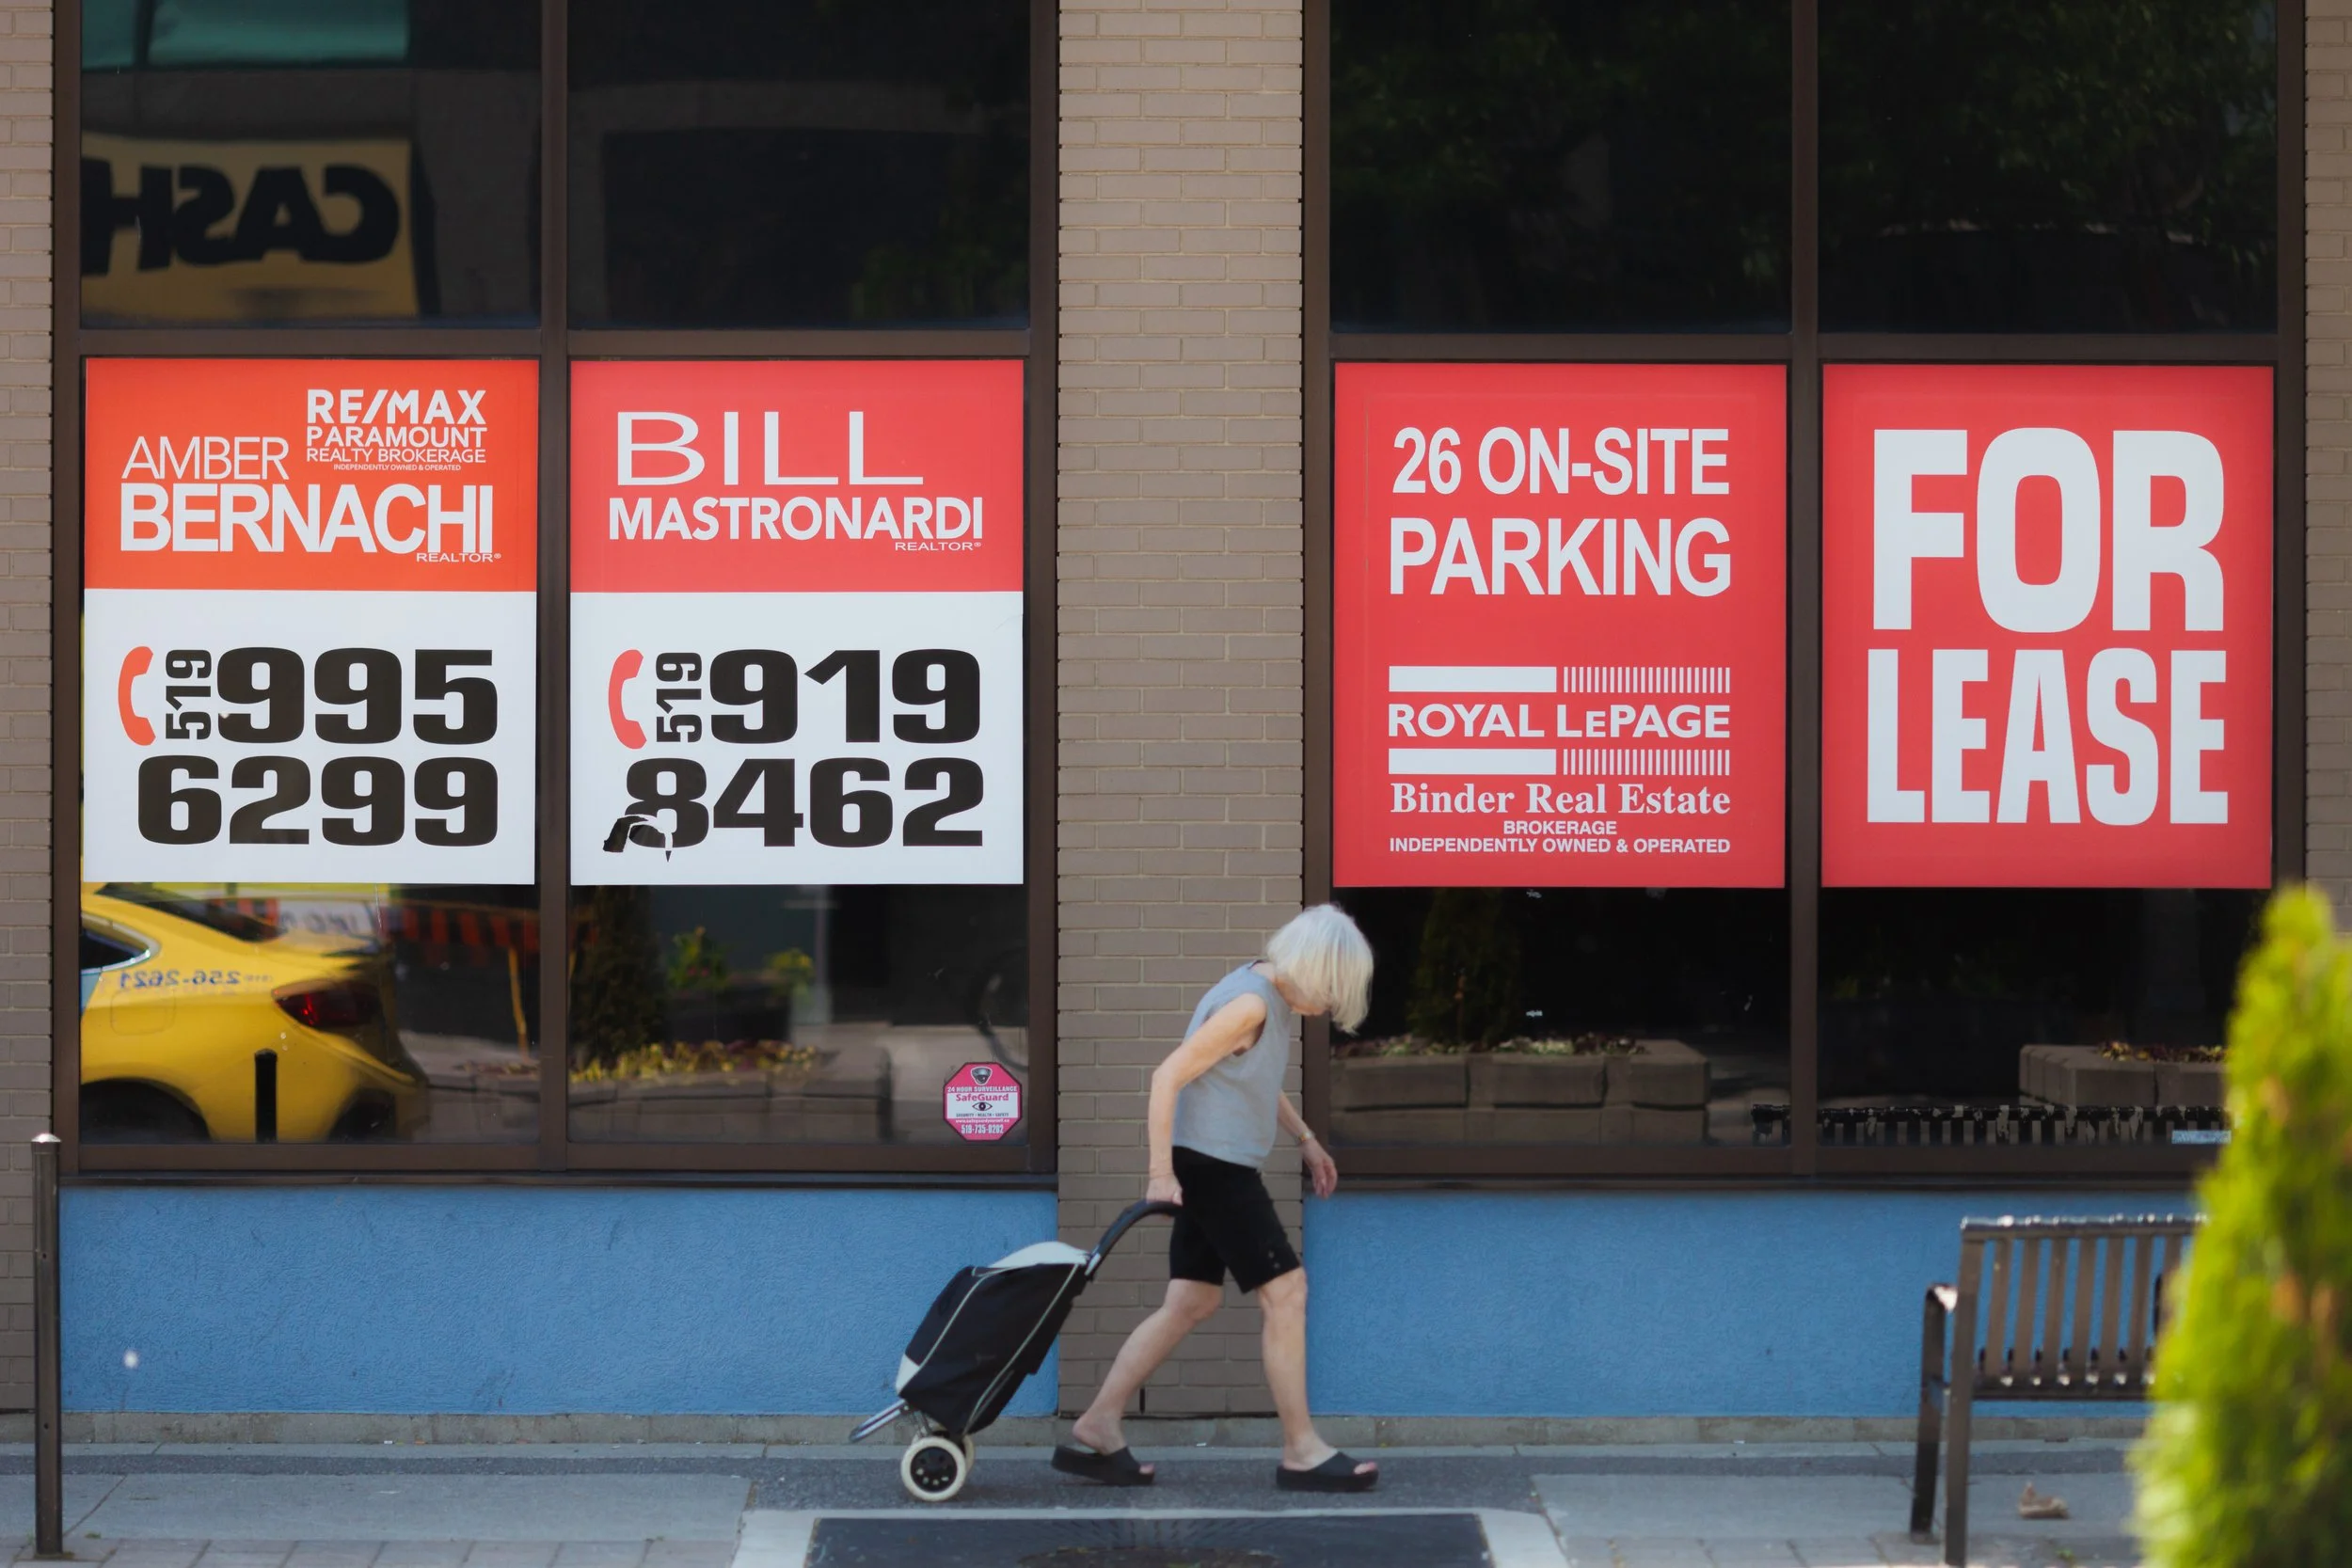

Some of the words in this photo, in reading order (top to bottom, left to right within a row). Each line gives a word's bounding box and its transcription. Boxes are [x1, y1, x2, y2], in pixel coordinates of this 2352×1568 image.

[307, 389, 486, 424] RE/MAX
[307, 427, 486, 448] PARAMOUNT
[122, 436, 289, 480] AMBER
[307, 448, 373, 462] REALTY
[379, 449, 485, 463] BROKERAGE
[617, 411, 924, 486] BILL
[1392, 427, 1461, 494] 26
[1478, 427, 1729, 495] ON-SITE
[120, 483, 492, 553] BERNACHI
[610, 497, 982, 540] MASTRONARDI
[1873, 427, 2224, 633] FOR
[1390, 517, 1731, 596] PARKING
[165, 649, 212, 740] 519
[217, 647, 498, 745] 995
[656, 652, 702, 743] 519
[709, 649, 980, 744] 919
[1389, 704, 1544, 737] ROYAL
[1867, 647, 2228, 826] LEASE
[138, 755, 498, 846] 6299
[624, 757, 983, 847] 8462
[1391, 783, 1515, 814] Binder
[1526, 783, 1606, 814] Real
[1618, 784, 1730, 815] Estate
[1503, 820, 1616, 835] BROKERAGE
[1390, 838, 1539, 852] INDEPENDENTLY
[1543, 838, 1611, 853] OWNED
[1615, 839, 1628, 852] &
[1634, 839, 1730, 853] OPERATED
